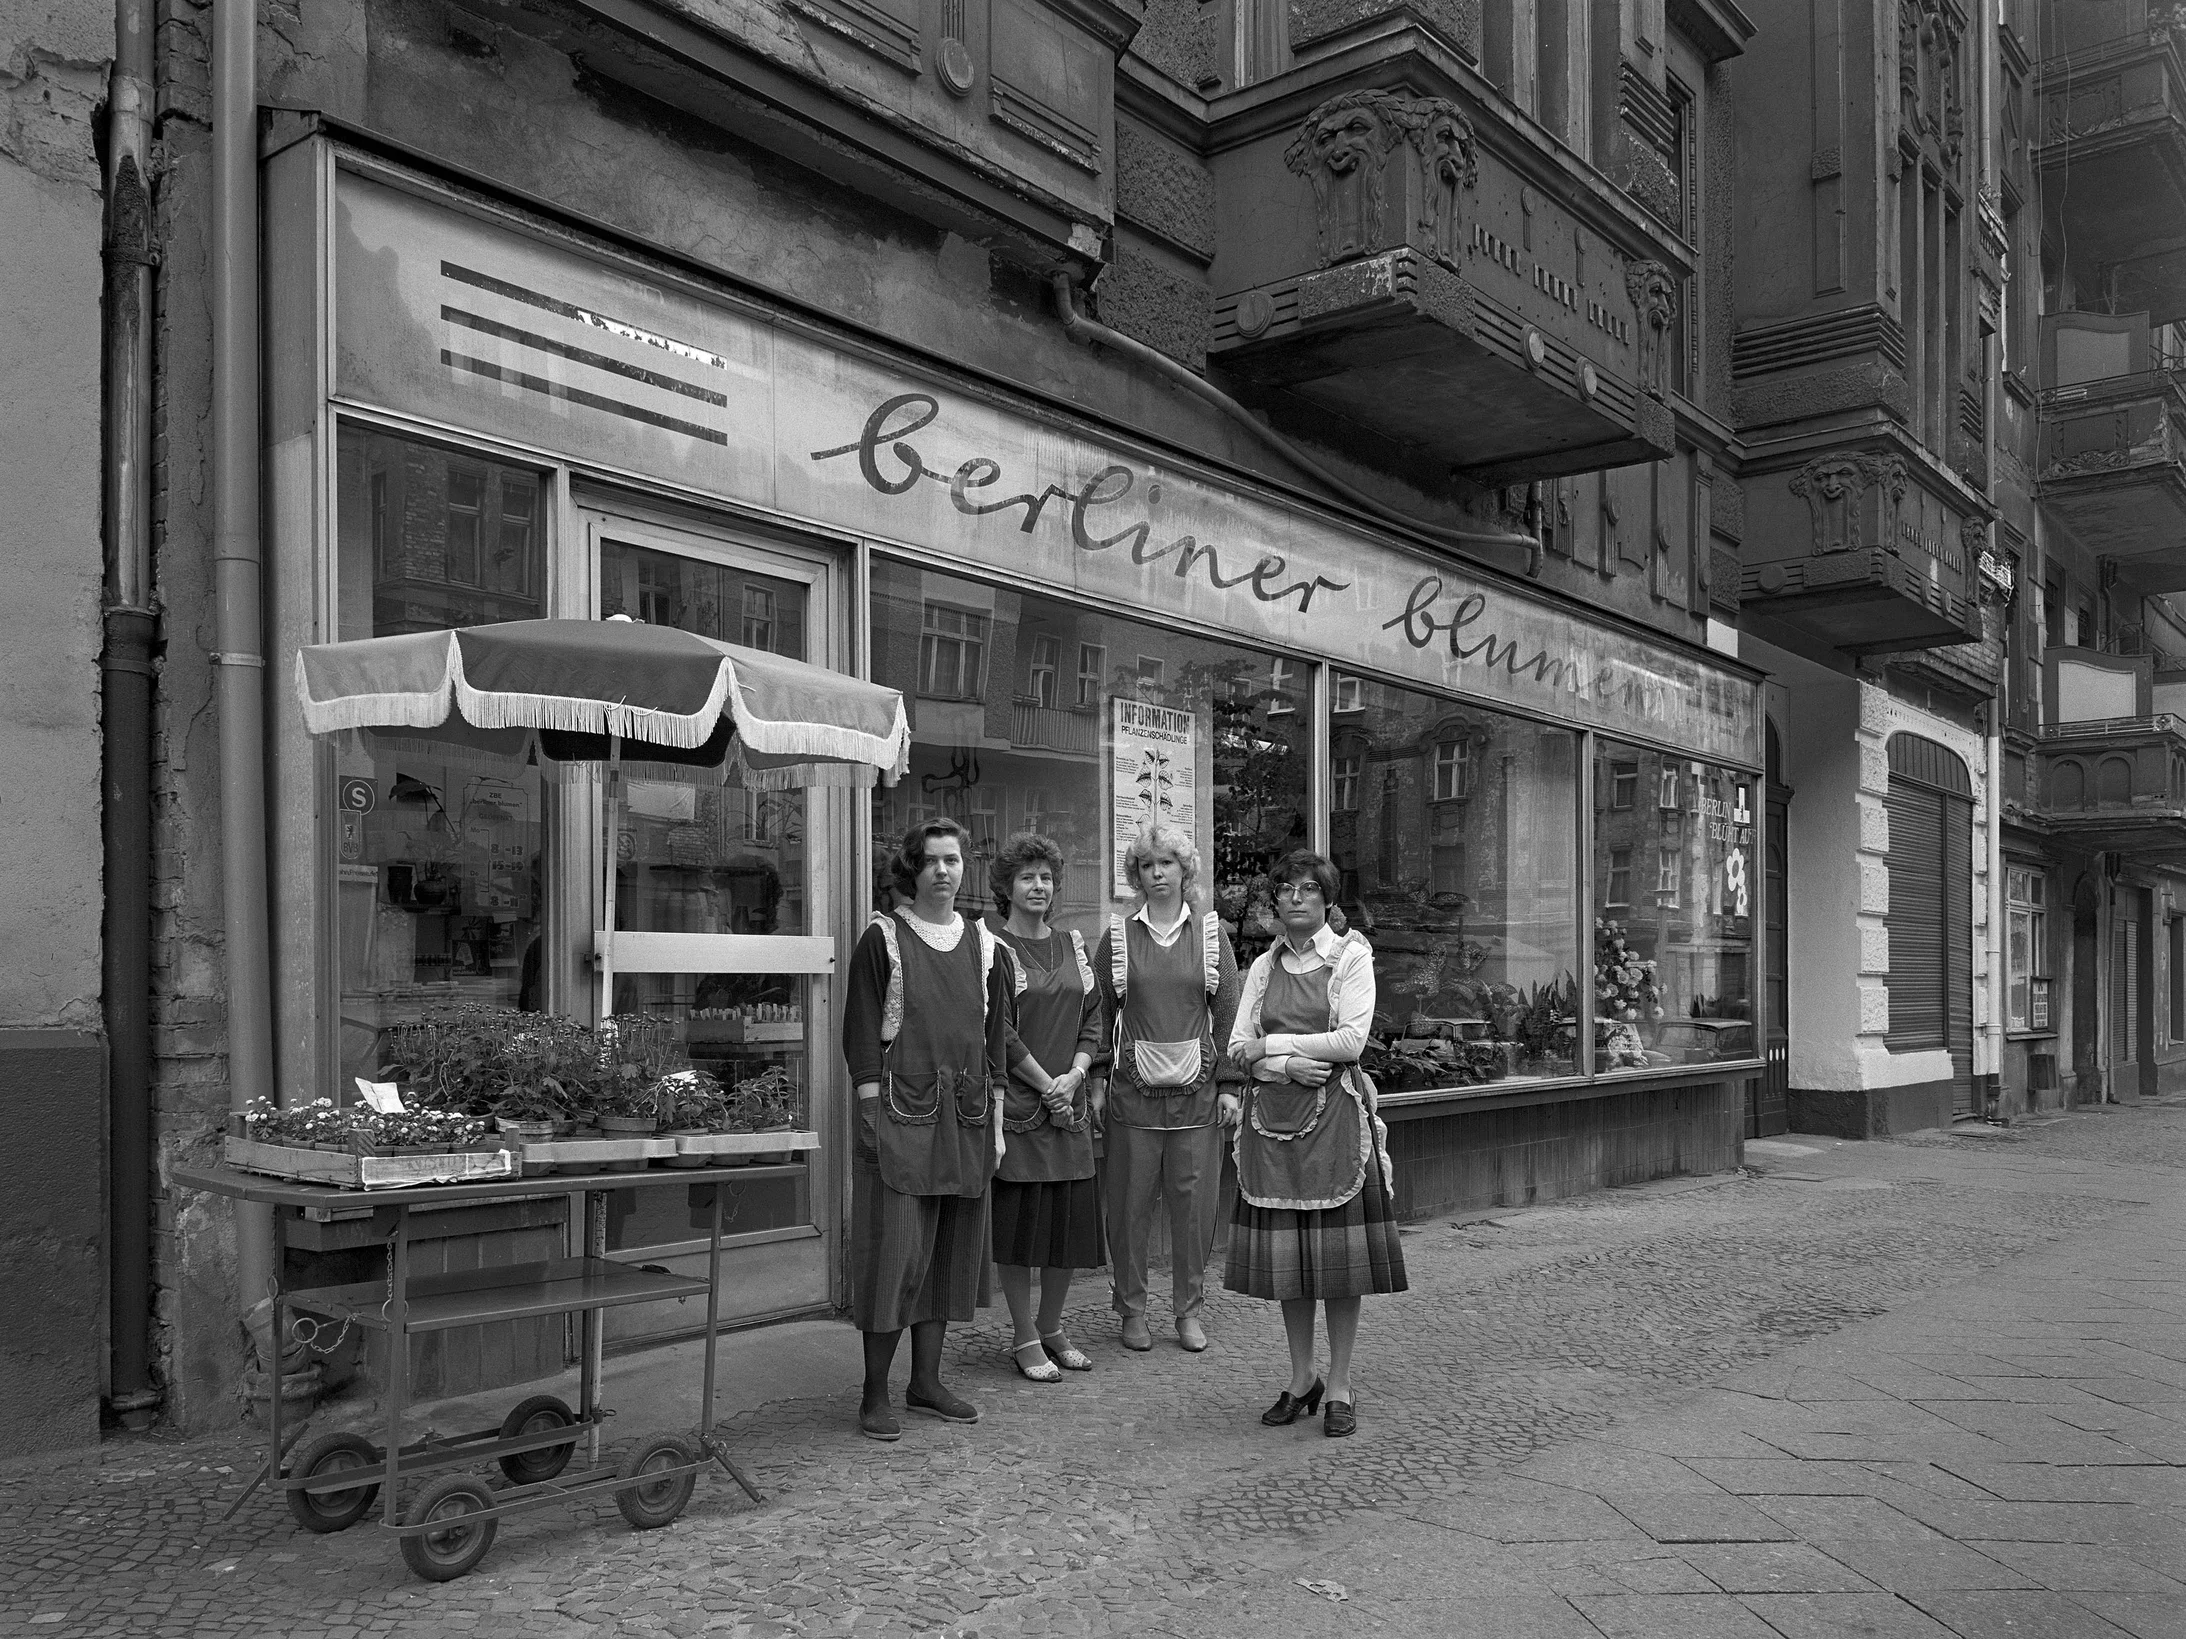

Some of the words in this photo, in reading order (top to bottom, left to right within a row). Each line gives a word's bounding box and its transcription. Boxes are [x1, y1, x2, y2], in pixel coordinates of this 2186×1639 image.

[811, 393, 1351, 613] berliner
[1120, 702, 1190, 734] INFORMATION
[1121, 725, 1187, 744] PFLANZENSCHÄDLINGE
[352, 787, 366, 807] S
[1699, 797, 1733, 825] BERLIN
